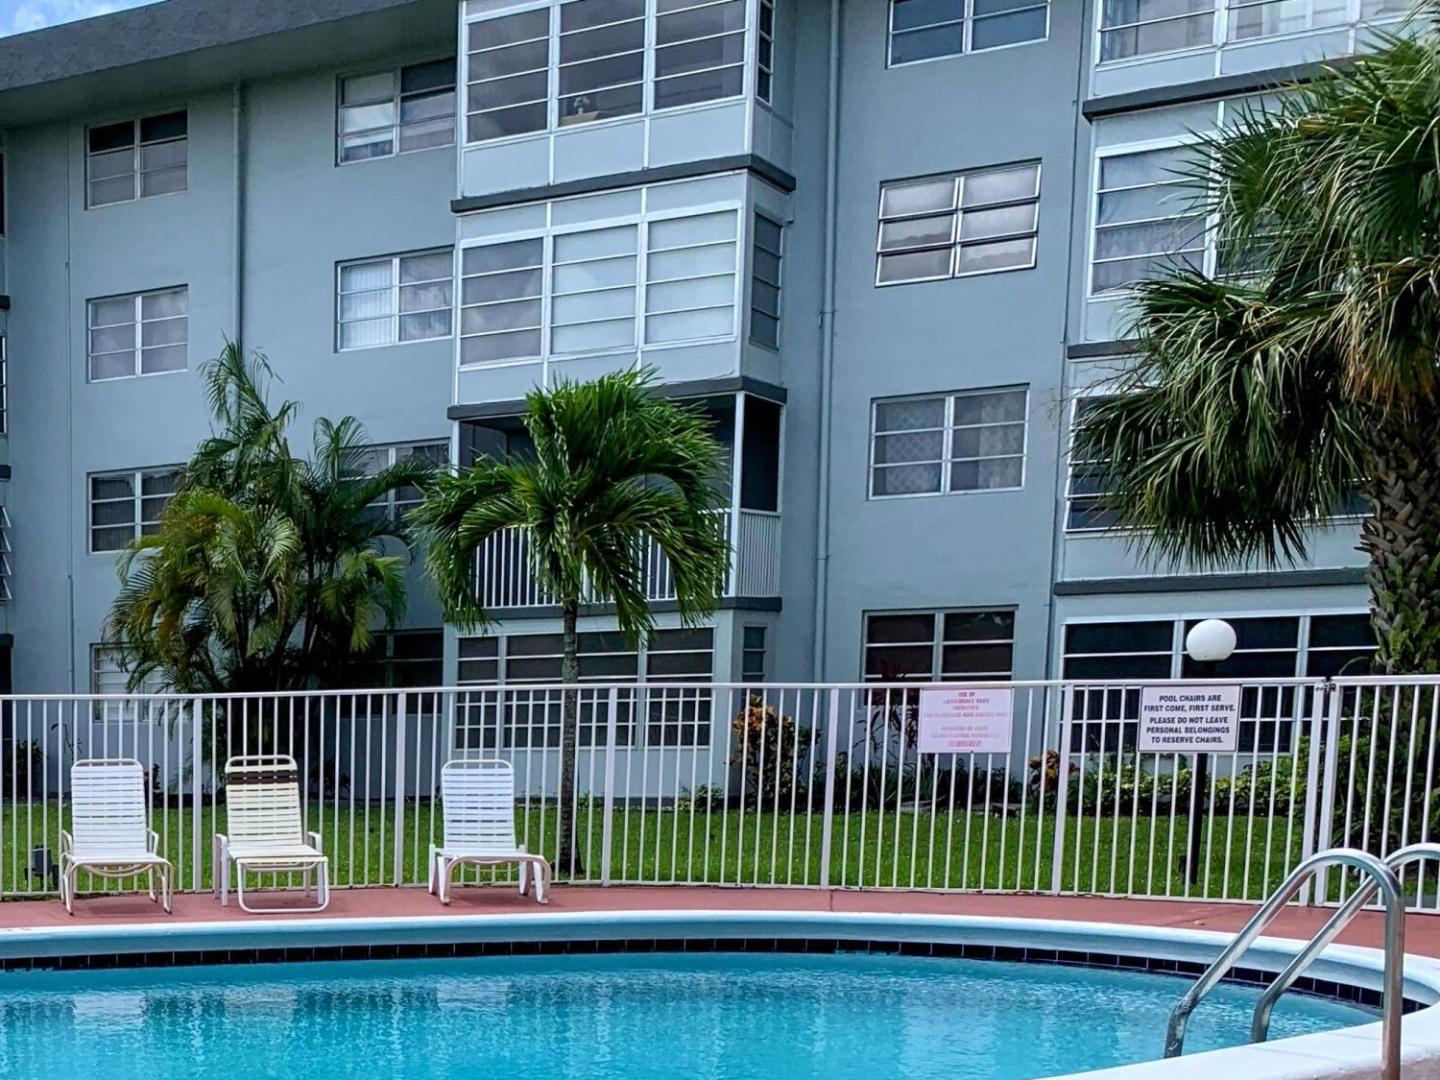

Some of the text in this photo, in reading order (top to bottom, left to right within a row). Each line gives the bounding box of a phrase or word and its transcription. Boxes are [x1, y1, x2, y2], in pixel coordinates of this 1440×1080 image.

[1207, 694, 1222, 702] ARE
[1165, 705, 1187, 713] COME,
[1211, 704, 1236, 712] SERVE.
[1205, 716, 1228, 724] LEAVE
